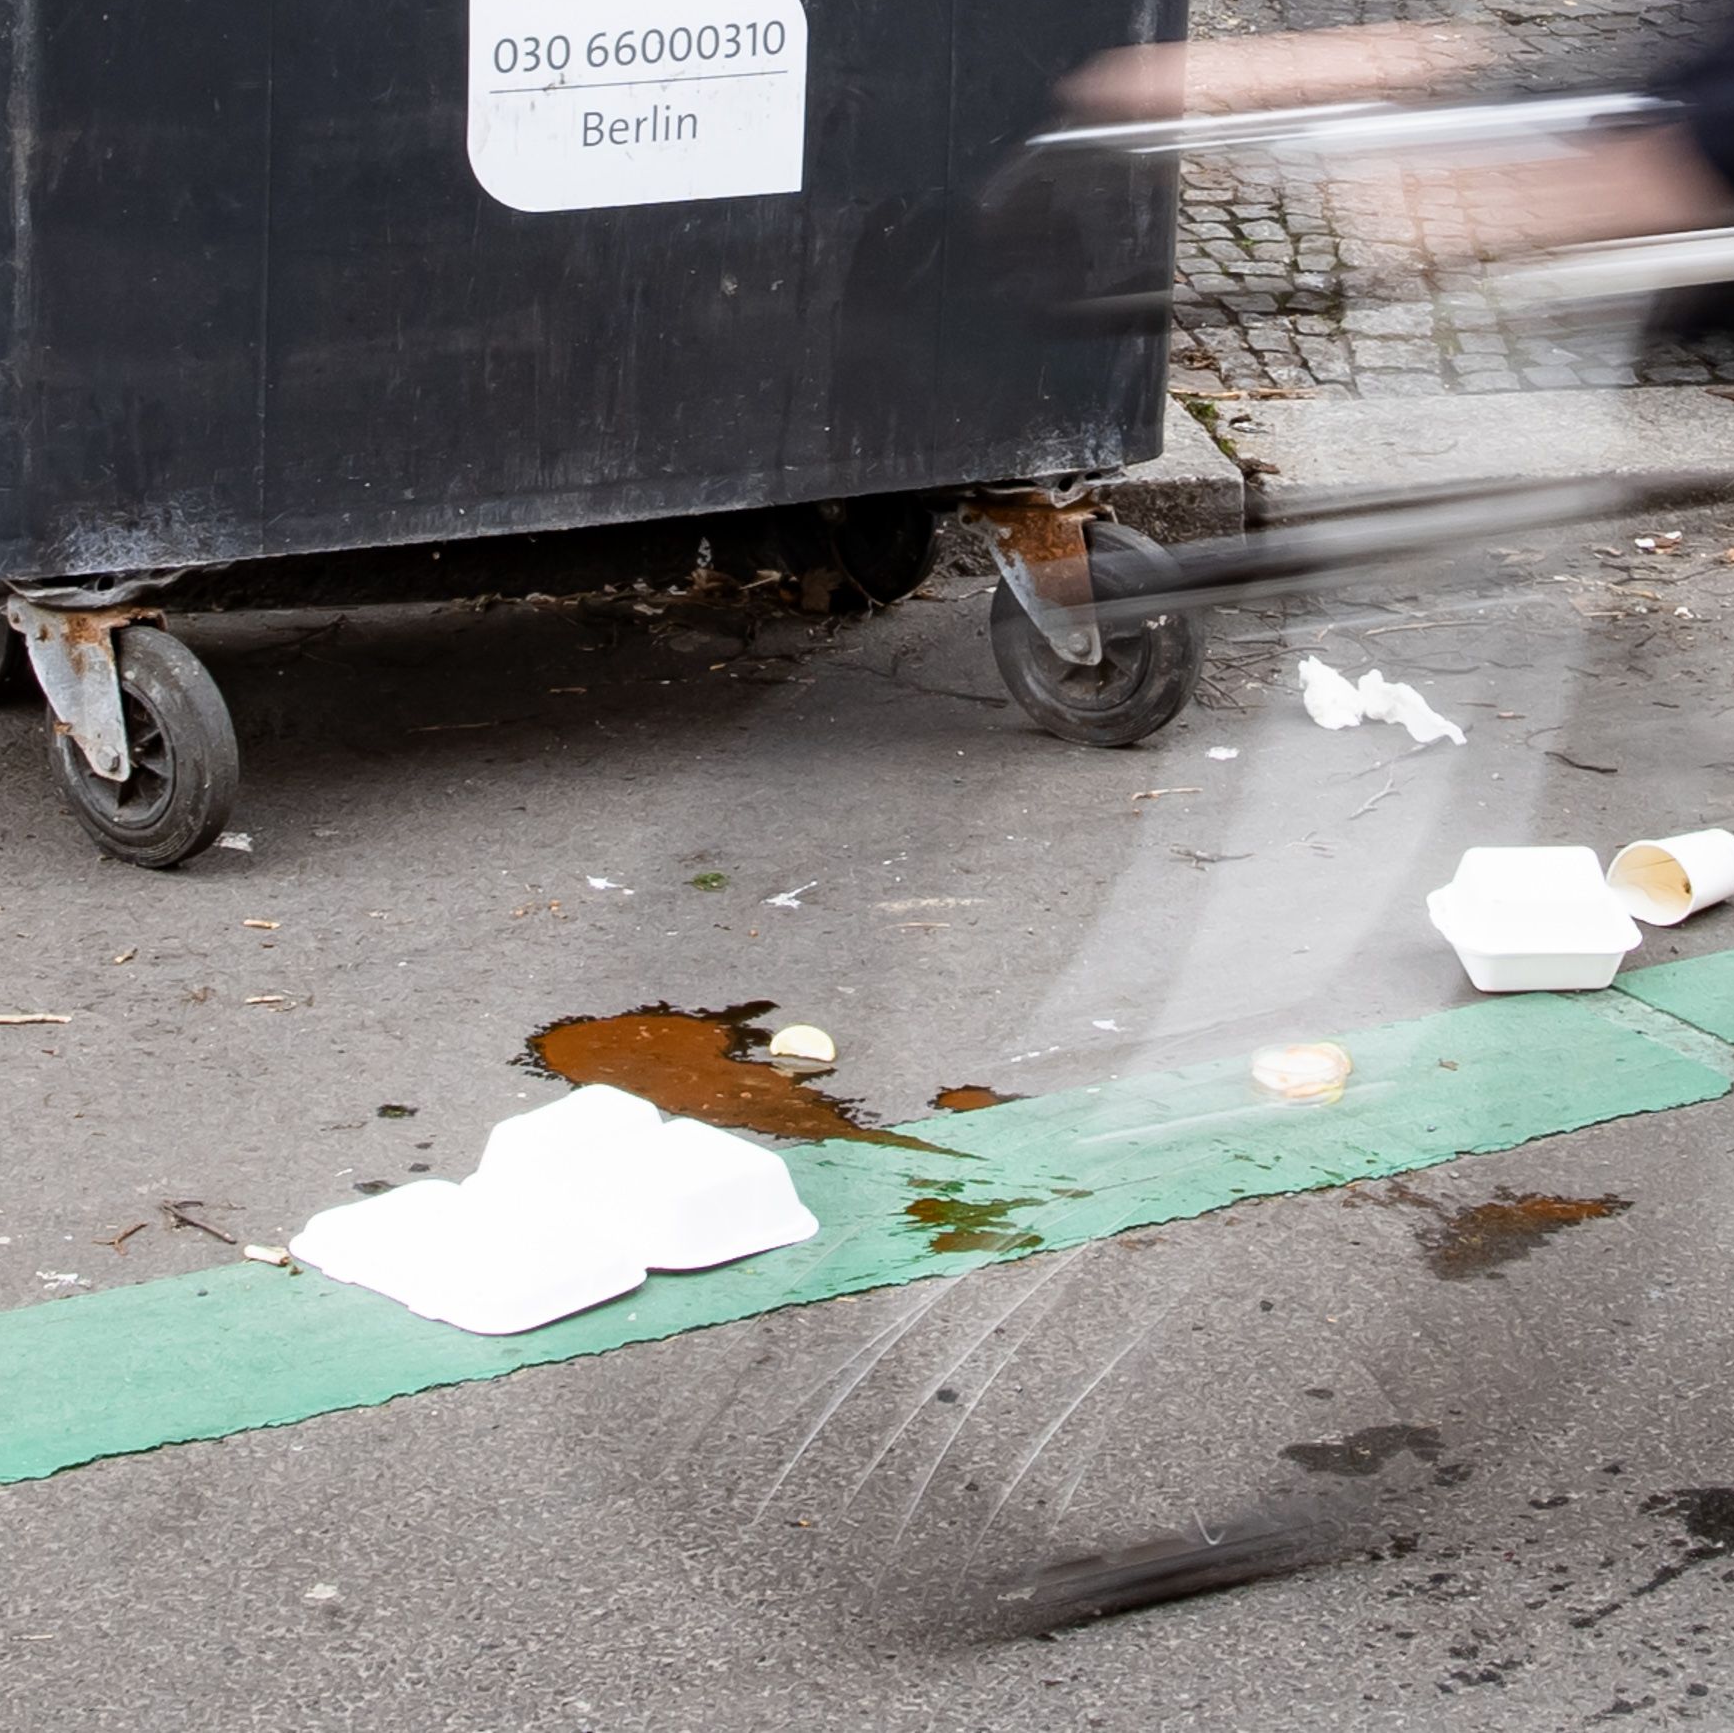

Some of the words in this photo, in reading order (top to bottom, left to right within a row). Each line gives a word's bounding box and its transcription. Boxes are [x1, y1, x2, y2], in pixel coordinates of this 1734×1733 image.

[493, 34, 571, 74] 030
[585, 19, 787, 69] 66000310
[582, 104, 699, 147] Berlin
